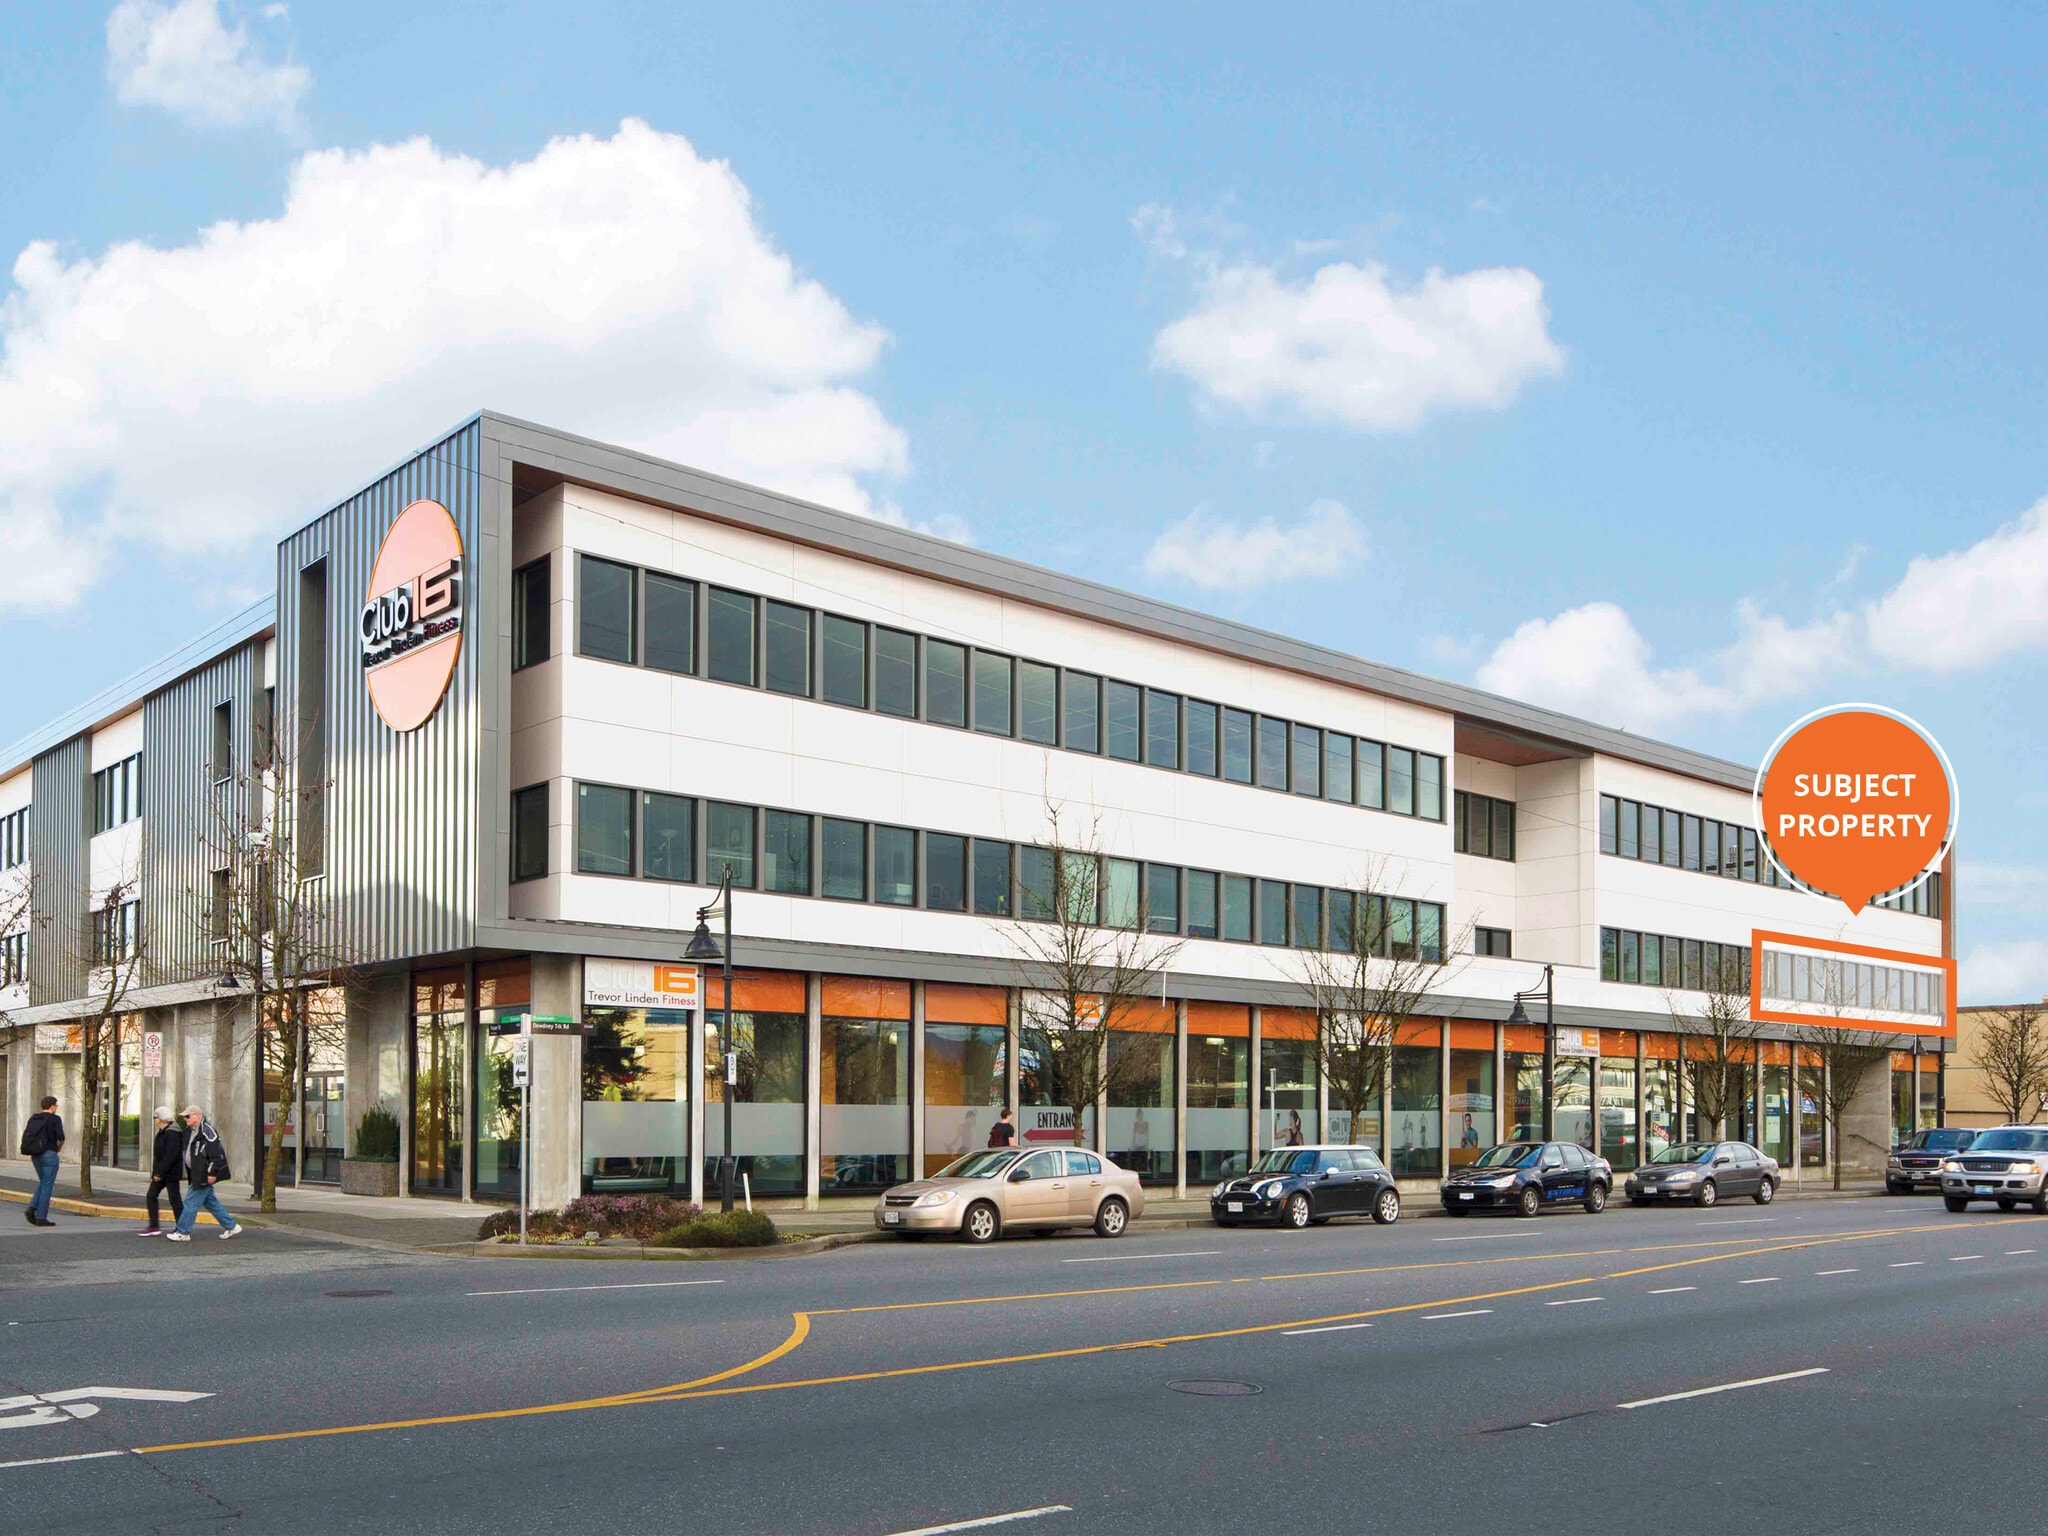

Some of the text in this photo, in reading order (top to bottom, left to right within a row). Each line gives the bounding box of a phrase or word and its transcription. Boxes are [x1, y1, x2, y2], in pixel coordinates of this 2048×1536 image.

[588, 990, 696, 1006] Trevor Linden Fitness
[516, 1041, 527, 1052] ONE
[1037, 1112, 1076, 1128] ENTRANC
